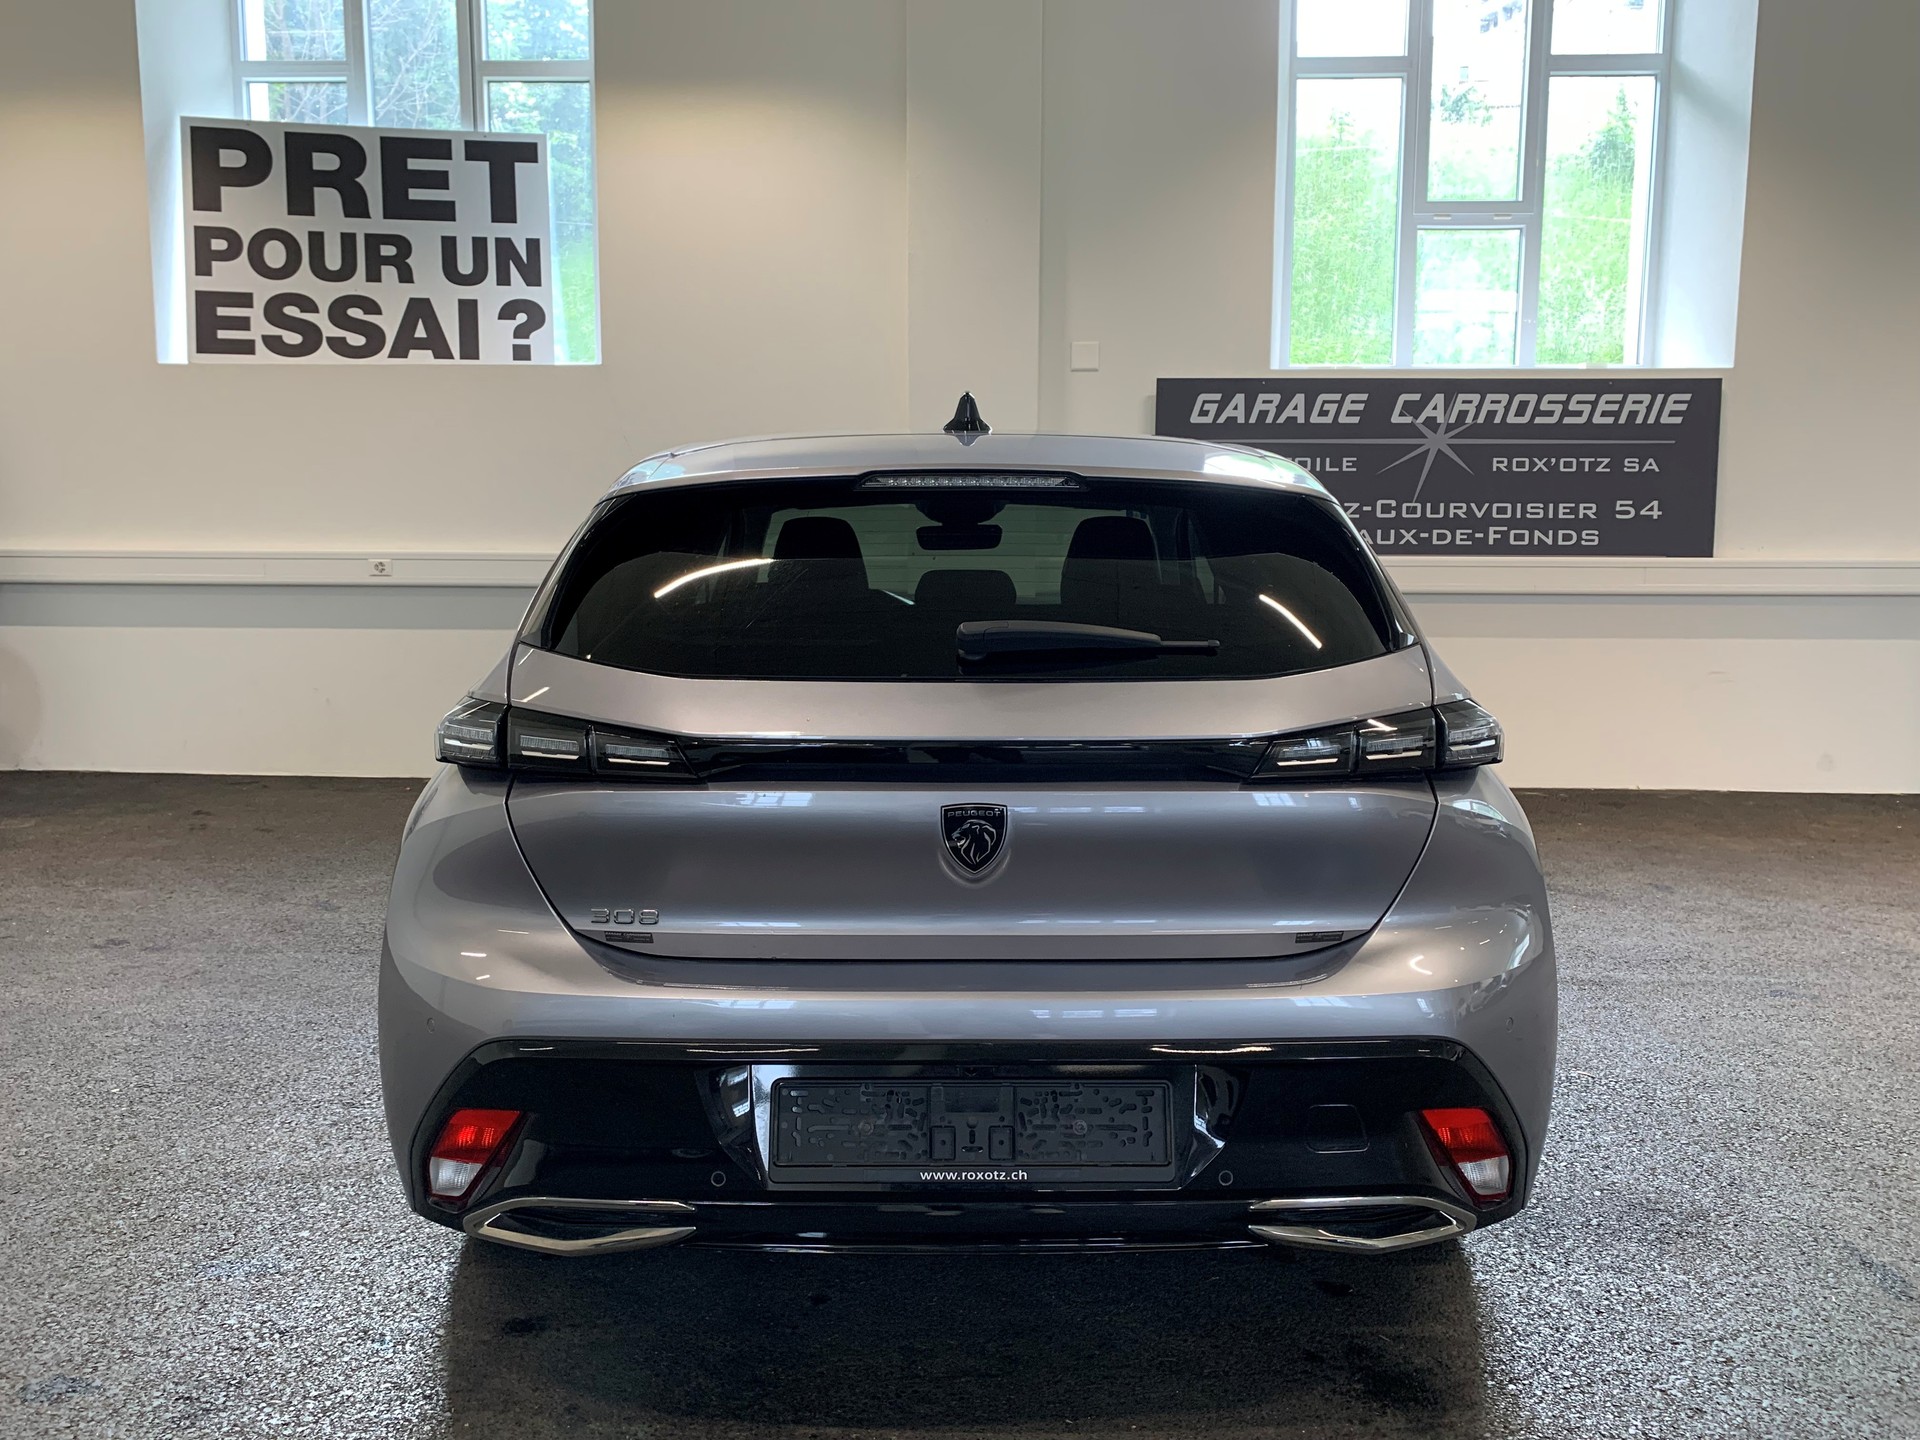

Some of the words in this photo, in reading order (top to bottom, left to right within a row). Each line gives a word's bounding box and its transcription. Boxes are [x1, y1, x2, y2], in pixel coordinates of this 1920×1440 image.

[190, 126, 539, 224] PRET
[194, 225, 415, 284] POUR
[441, 235, 542, 287] UN
[195, 290, 480, 361] ESSAI
[1189, 393, 1369, 424] GARAGE
[1390, 392, 1693, 424] CARROSSERIE
[1288, 457, 1358, 472] OILE
[1492, 457, 1611, 472] ROX'OTZ
[1623, 457, 1660, 472] SA
[1615, 500, 1663, 520] 54
[947, 809, 1001, 818] PEUGEOT
[590, 907, 660, 925] 308
[920, 1169, 1028, 1180] www.roxotz.ch
